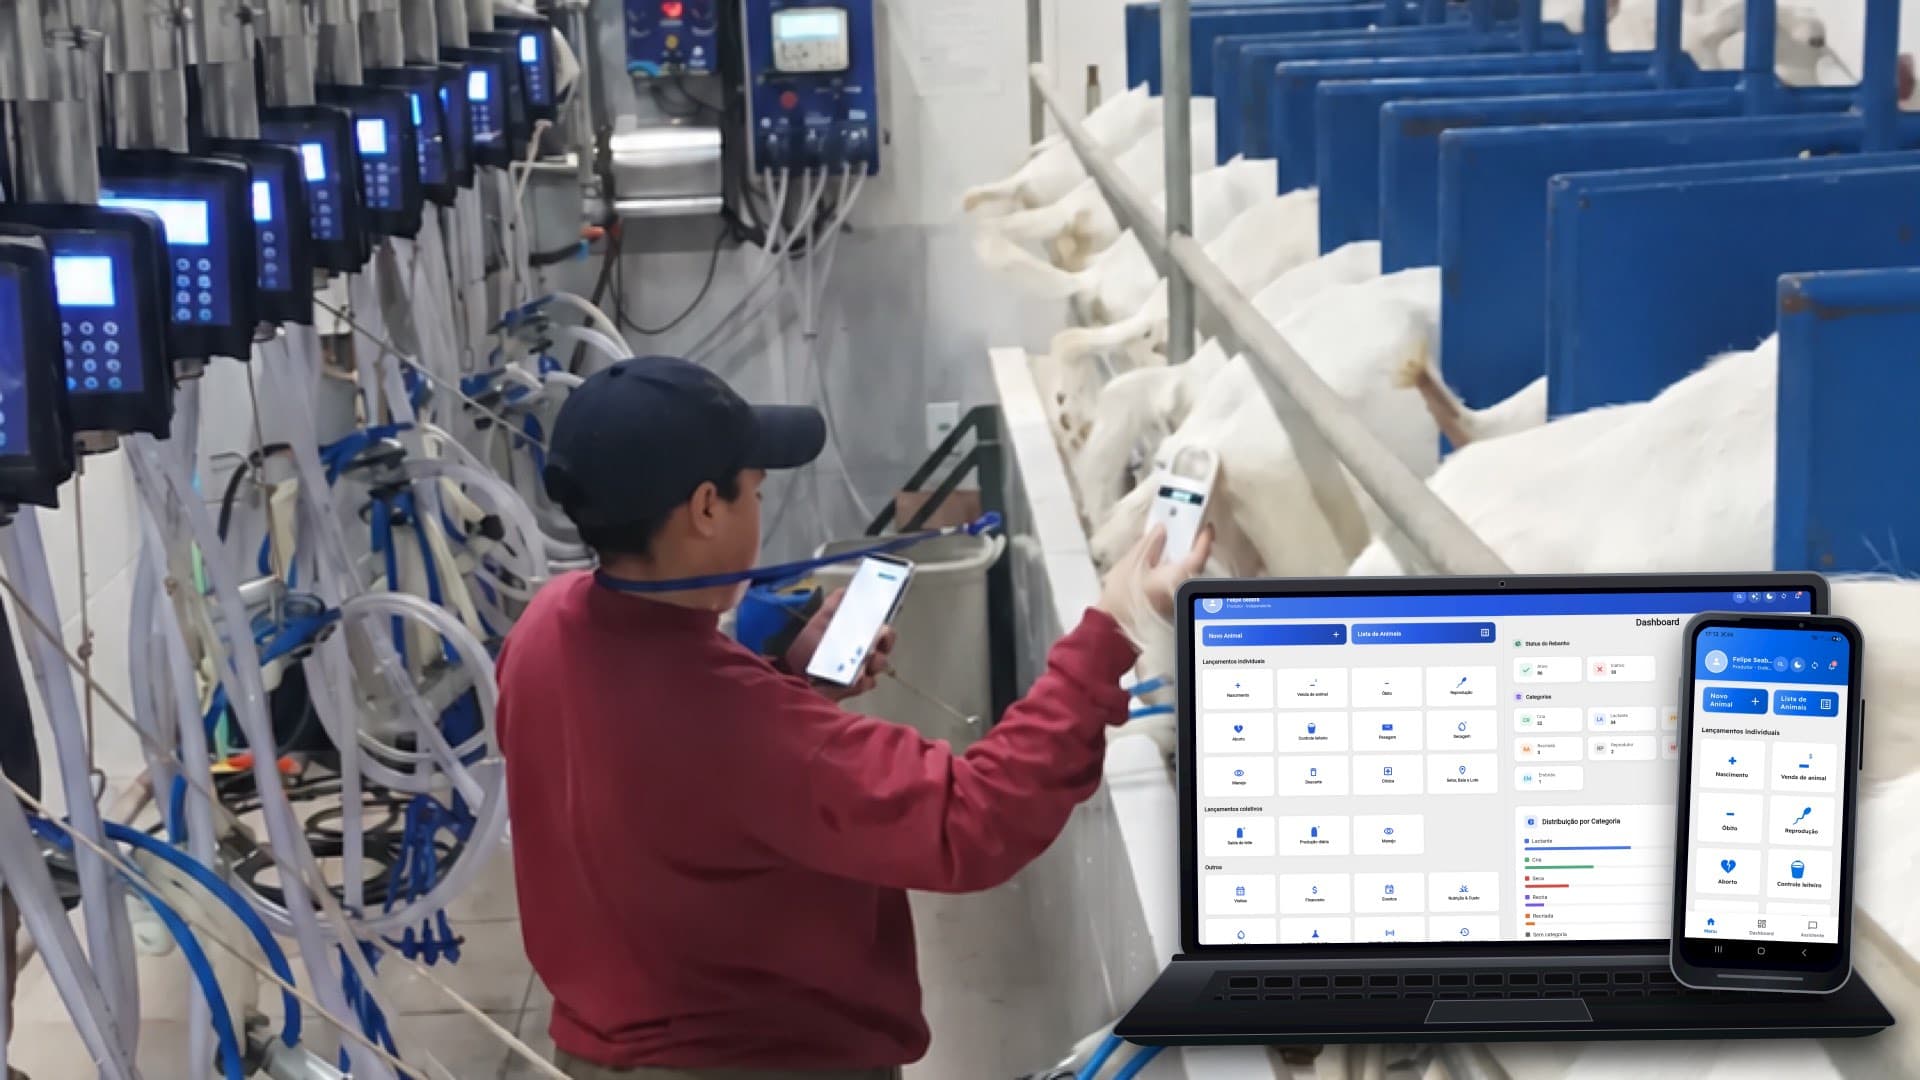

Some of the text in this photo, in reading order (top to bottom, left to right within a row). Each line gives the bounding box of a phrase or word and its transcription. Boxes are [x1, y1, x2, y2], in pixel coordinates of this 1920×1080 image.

[1636, 617, 1680, 627] Dashboard
[1732, 656, 1752, 664] Felipe
[1780, 703, 1807, 711] Animais
[1701, 727, 1780, 736] Lançamentos individuais
[1542, 818, 1621, 827] Distribuição por Categoria
[1784, 827, 1819, 835] Reprodução
